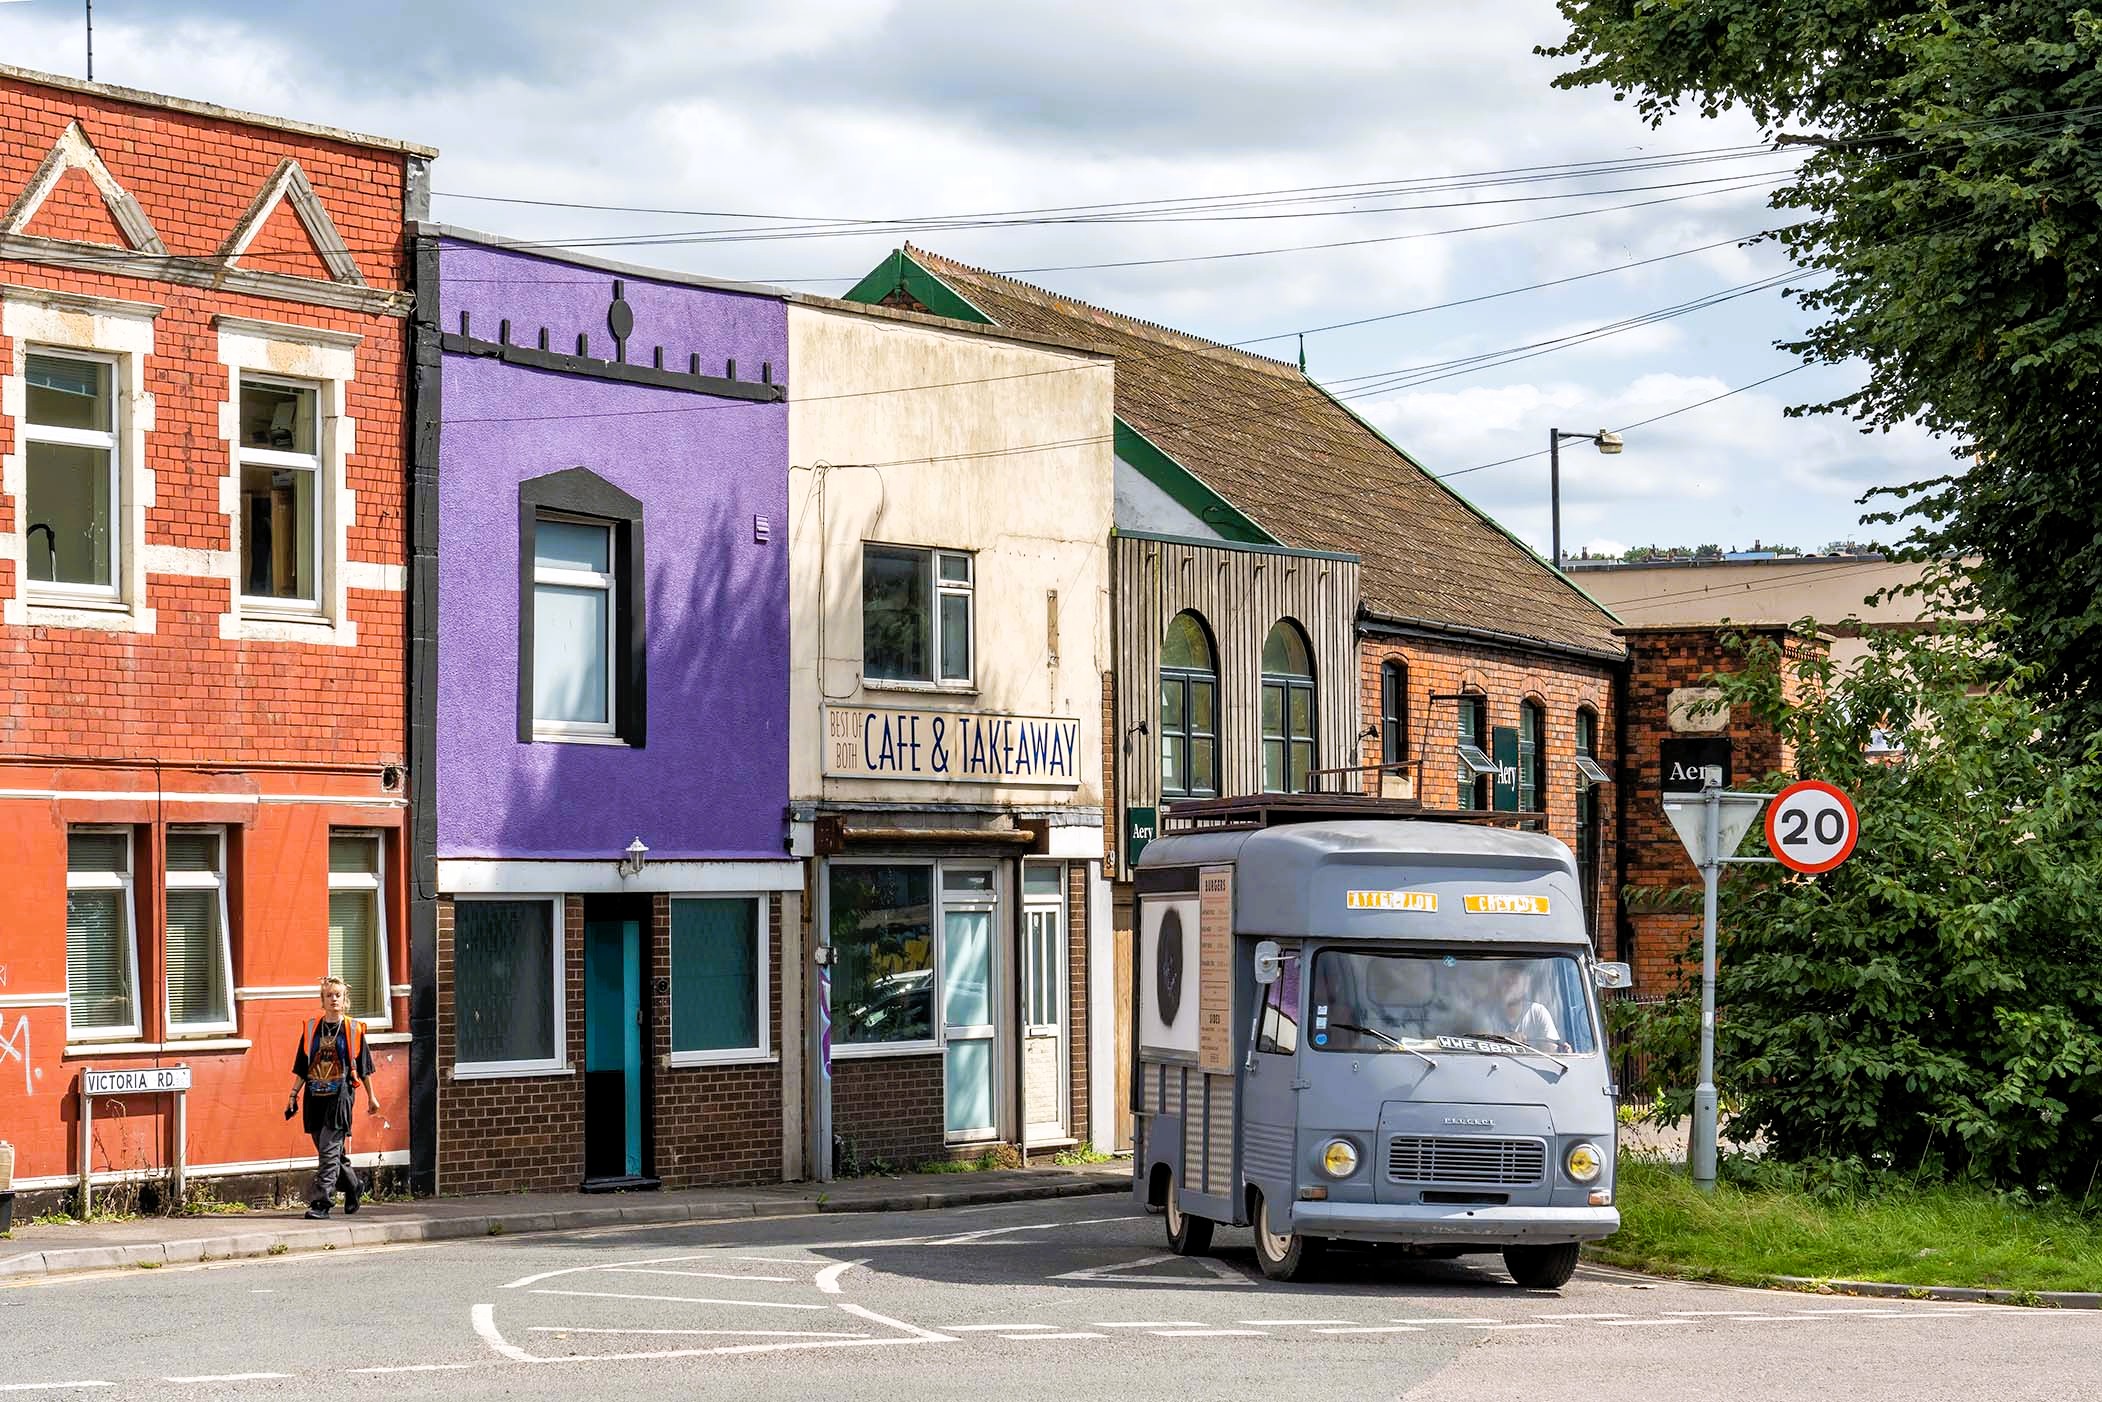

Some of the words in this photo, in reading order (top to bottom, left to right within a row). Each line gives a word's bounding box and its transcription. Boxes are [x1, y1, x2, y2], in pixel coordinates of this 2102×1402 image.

[830, 710, 849, 738] BEST
[851, 711, 863, 738] OF
[836, 742, 858, 769] BOTH
[864, 712, 921, 772] CAFE
[931, 716, 949, 773] &
[959, 717, 1076, 776] TAKEAWAY
[1497, 759, 1517, 792] Aery
[1669, 761, 1707, 793] Aer
[1132, 823, 1154, 843] Aery
[1781, 808, 1844, 845] 20
[1440, 1037, 1476, 1050] WWE
[88, 1073, 148, 1091] VICTORIA
